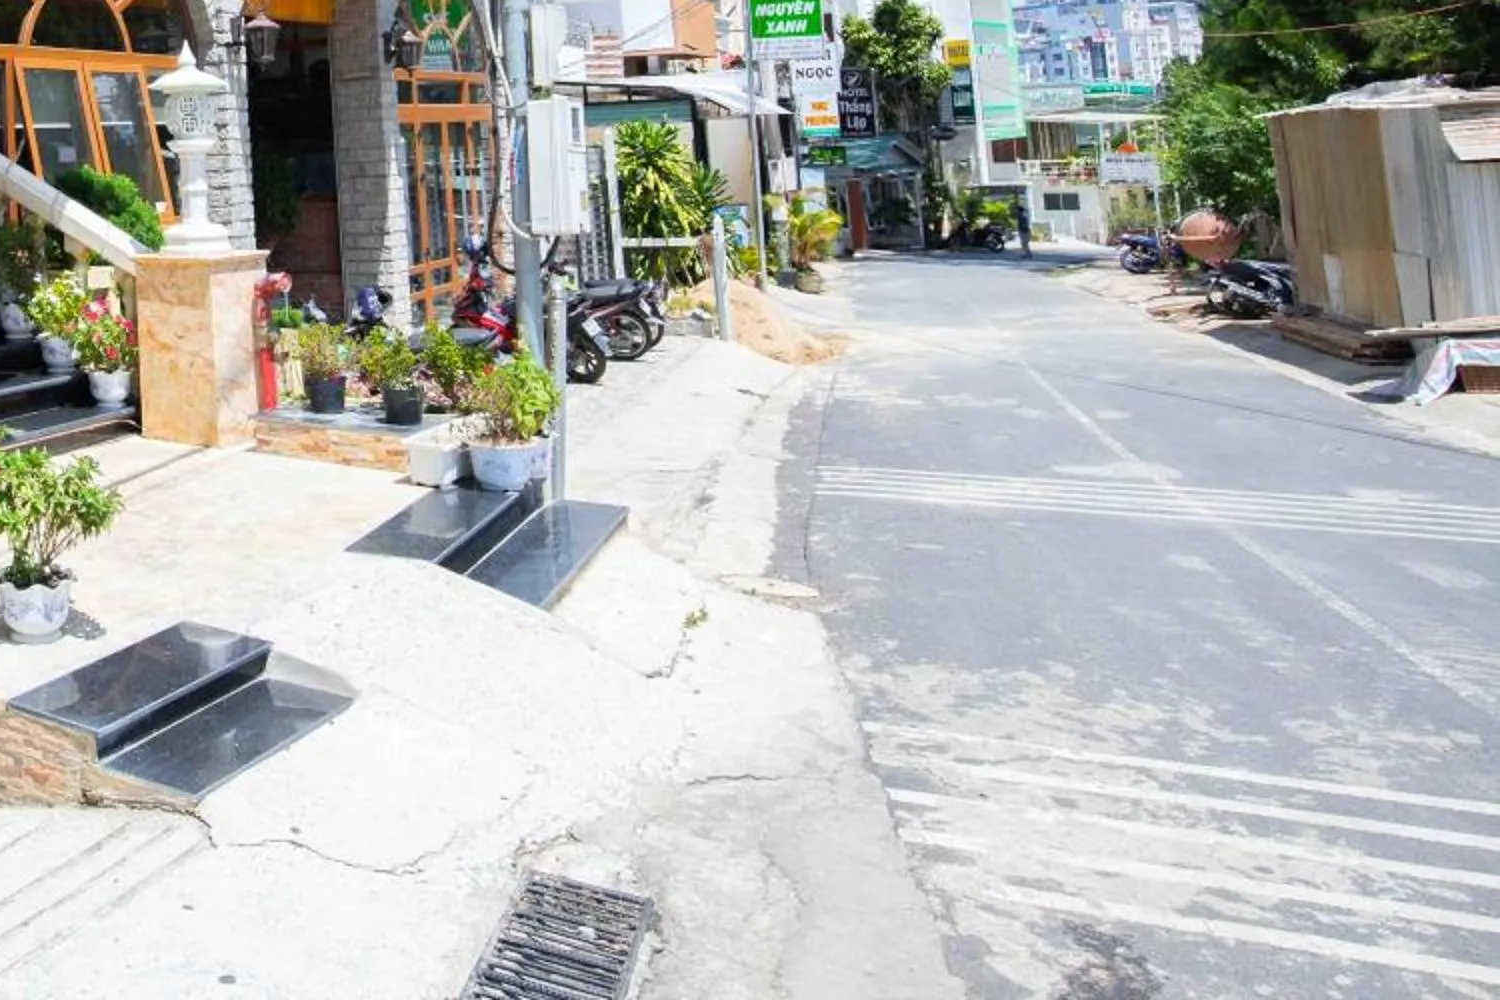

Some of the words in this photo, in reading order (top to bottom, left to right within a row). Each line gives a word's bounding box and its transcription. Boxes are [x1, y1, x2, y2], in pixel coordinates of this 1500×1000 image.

[755, 0, 816, 18] NGUYÊN
[765, 18, 808, 35] XANH
[795, 66, 835, 80] NGỌC
[840, 87, 870, 97] HOTEL
